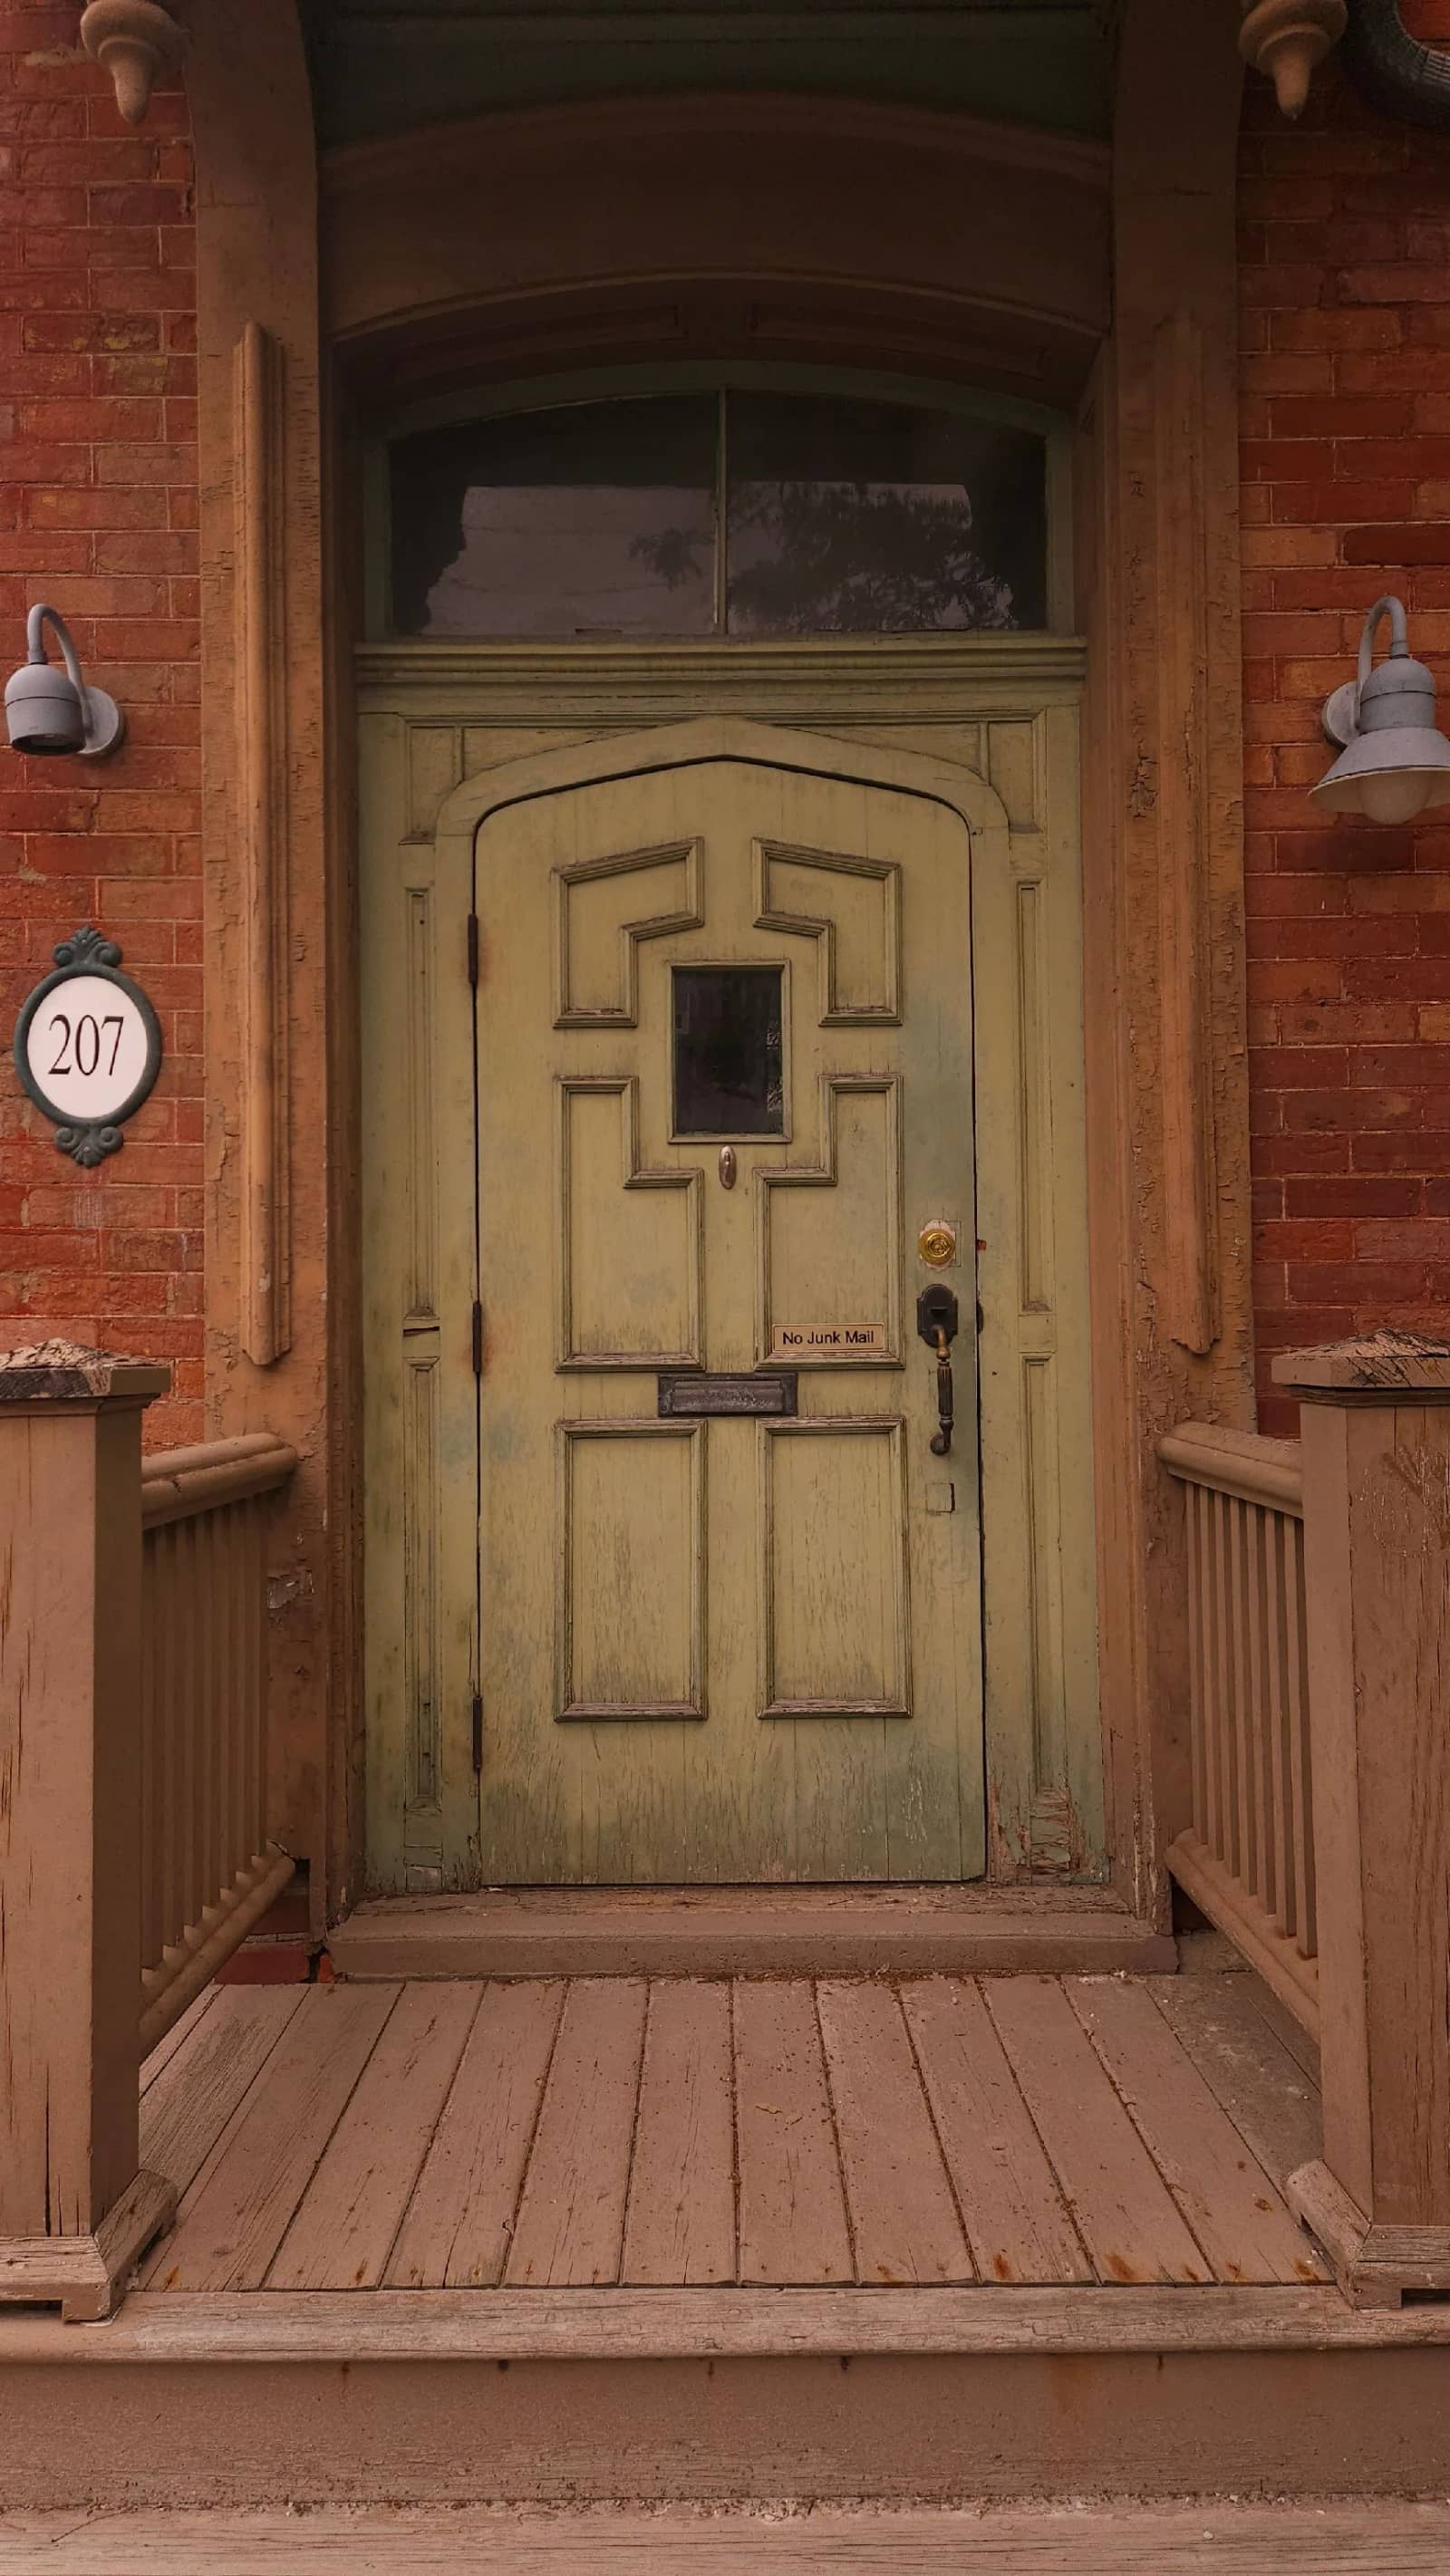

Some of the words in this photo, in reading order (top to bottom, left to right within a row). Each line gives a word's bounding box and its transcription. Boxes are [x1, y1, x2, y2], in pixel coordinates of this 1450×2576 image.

[48, 1014, 124, 1076] 207
[783, 1332, 803, 1345] No
[807, 1331, 841, 1344] Junk
[846, 1330, 874, 1343] Mail
